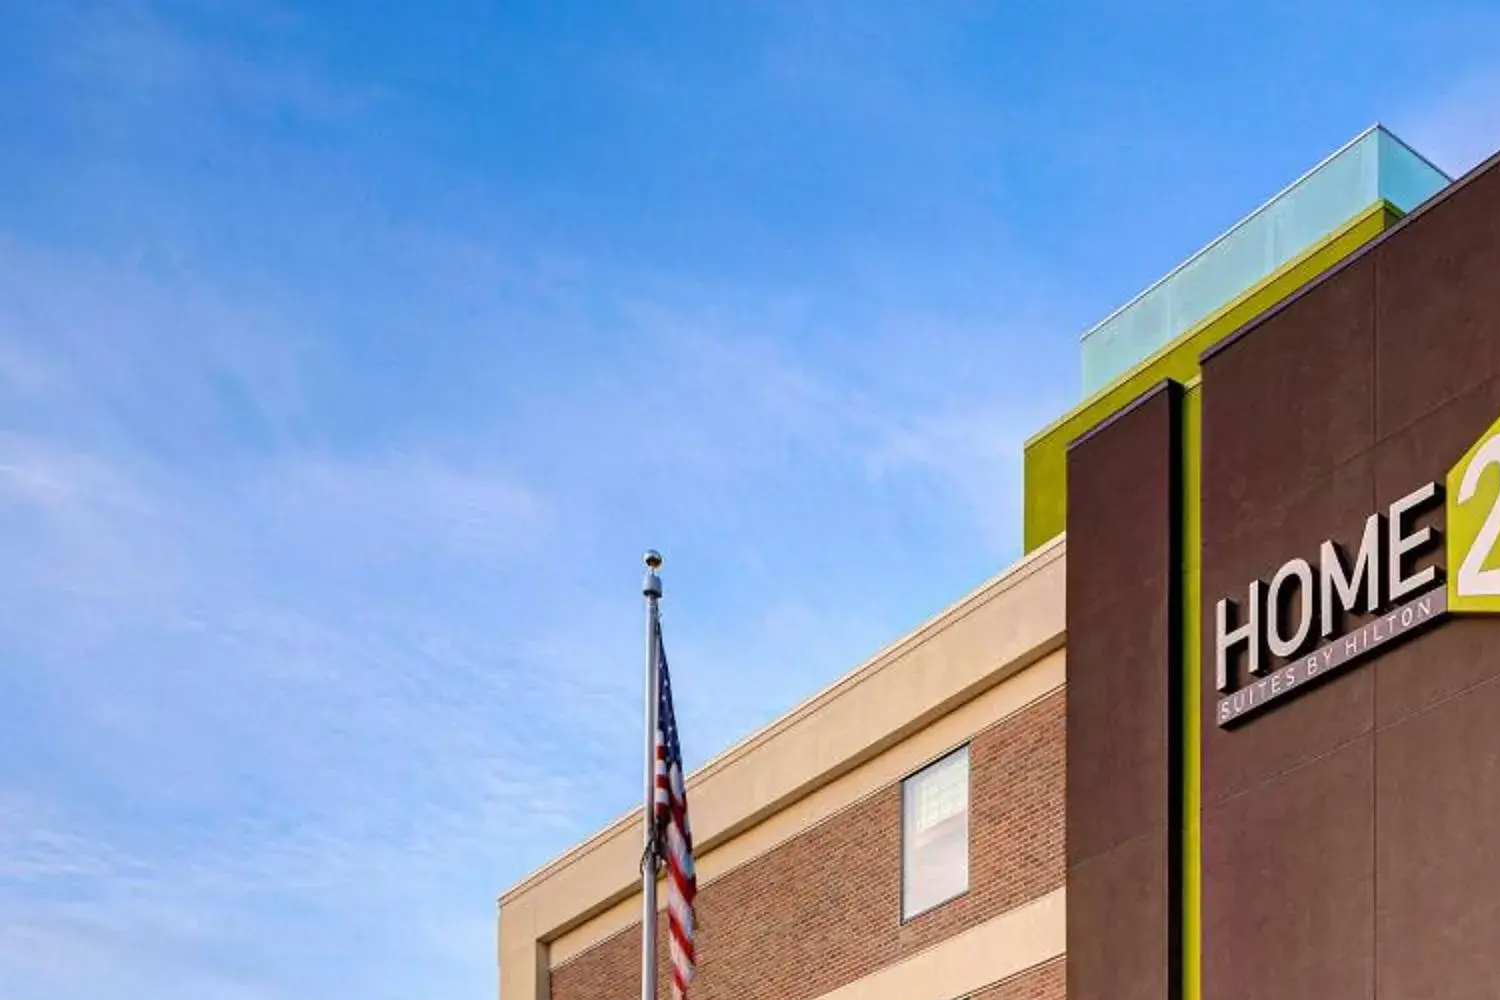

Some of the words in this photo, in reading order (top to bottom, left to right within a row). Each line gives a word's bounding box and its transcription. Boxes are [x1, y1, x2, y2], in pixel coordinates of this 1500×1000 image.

[1216, 481, 1437, 691] HOME
[1220, 667, 1296, 720] SUITES
[1306, 648, 1334, 676] BY
[1344, 599, 1432, 657] HILTON
